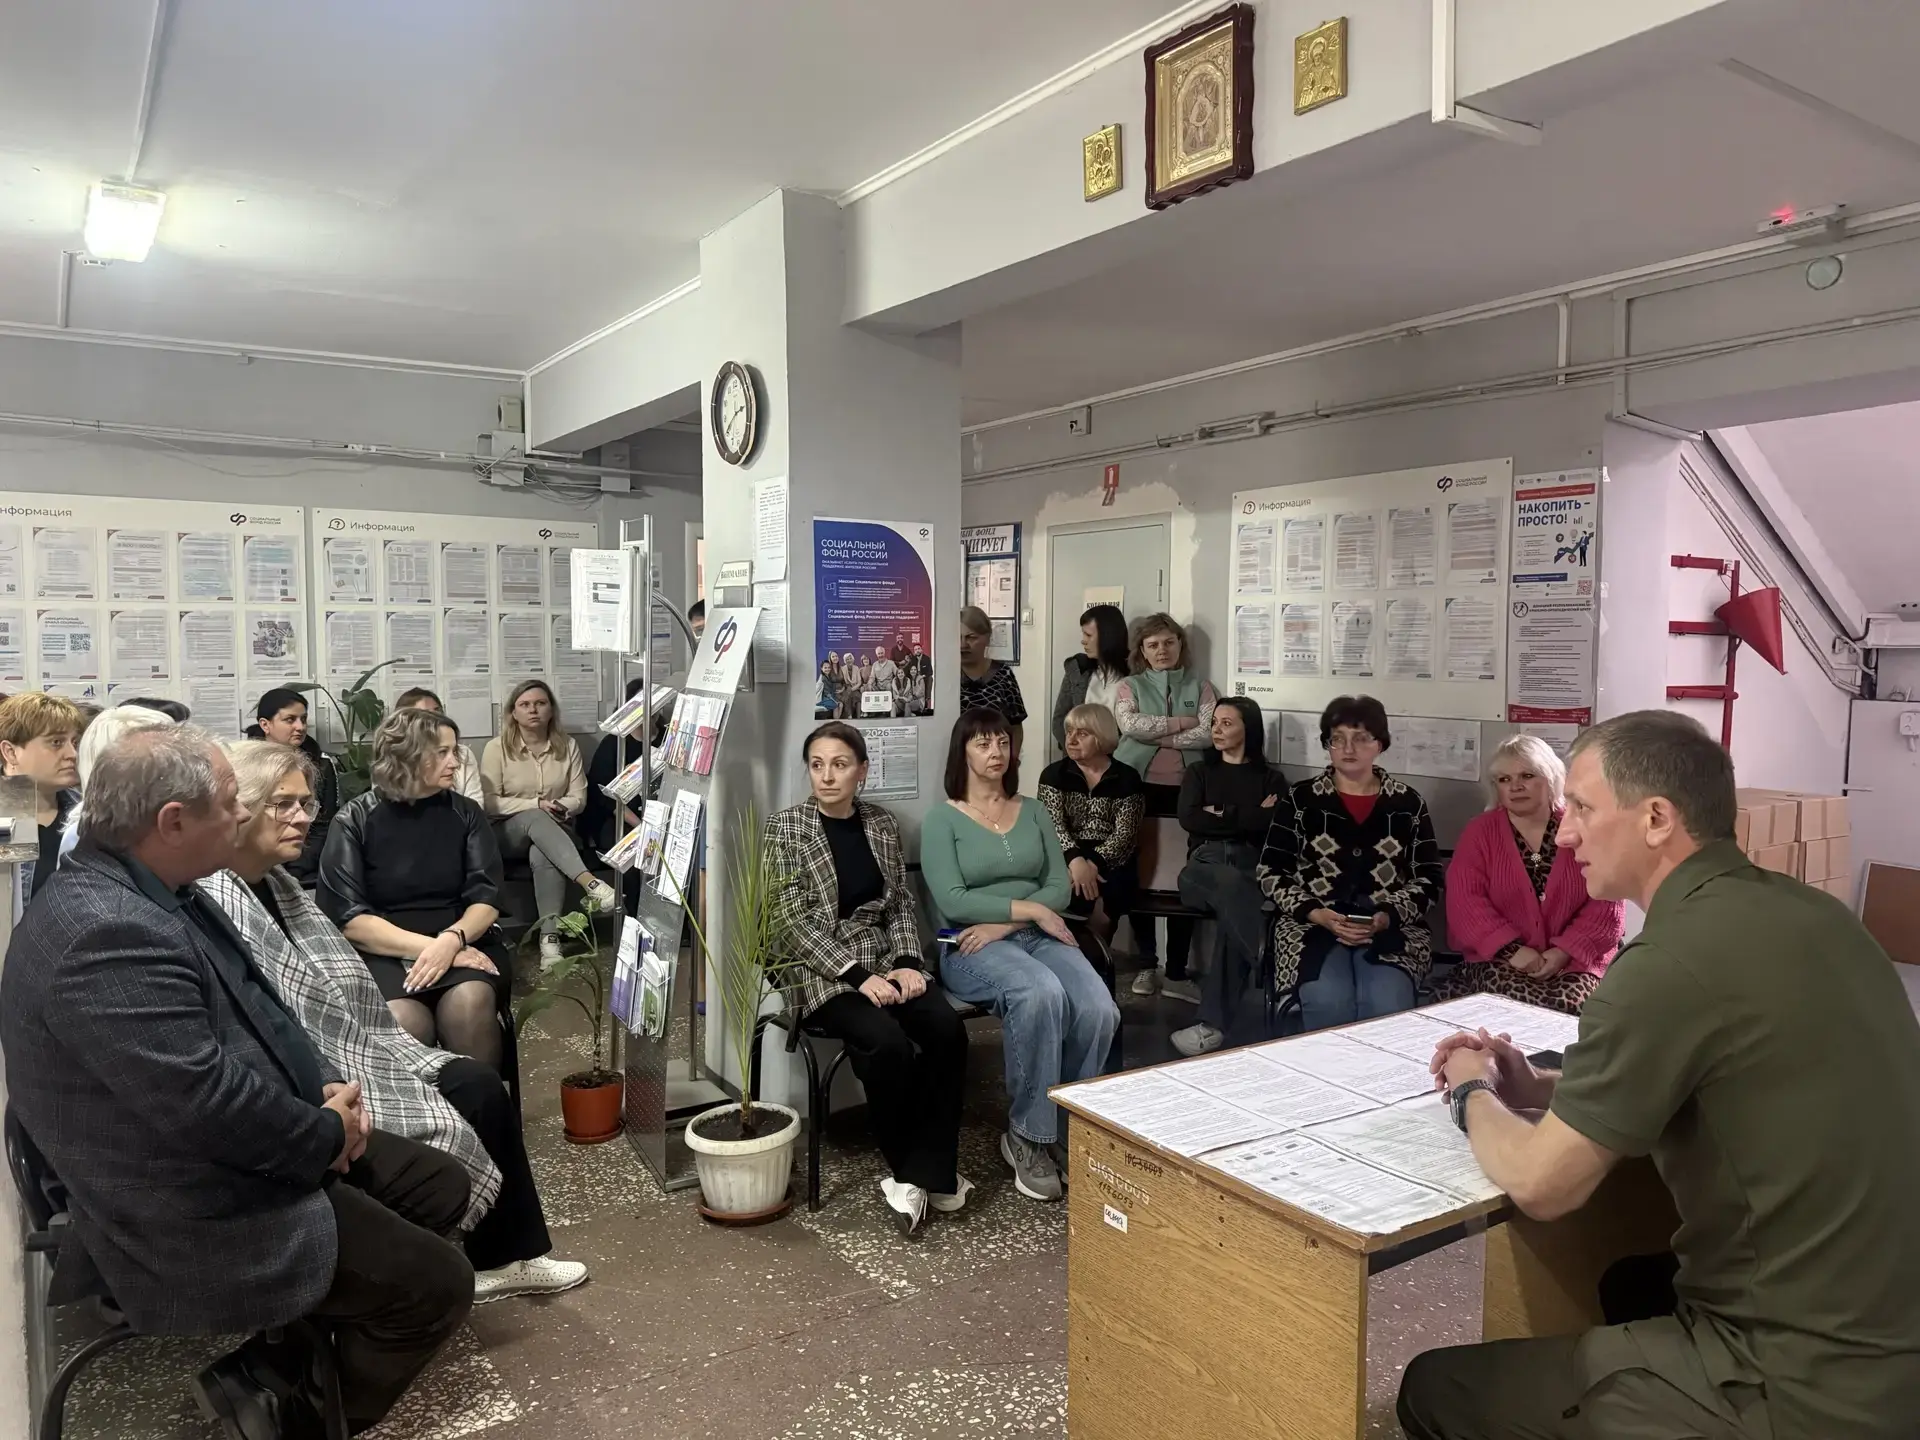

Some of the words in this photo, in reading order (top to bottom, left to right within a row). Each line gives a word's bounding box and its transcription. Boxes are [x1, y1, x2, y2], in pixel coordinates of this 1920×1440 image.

[1258, 499, 1311, 512] Информация
[1518, 500, 1581, 514] НАКОПИТЬ
[0, 505, 72, 518] нформация
[1517, 513, 1567, 527] ПРОСТО!
[350, 521, 415, 532] Информация
[976, 528, 996, 536] ФОНД
[821, 539, 886, 550] СОЦИАЛЬНЫЙ
[821, 549, 849, 558] ФОНД
[851, 550, 888, 559] РОССИИ
[866, 729, 890, 737] 2026
